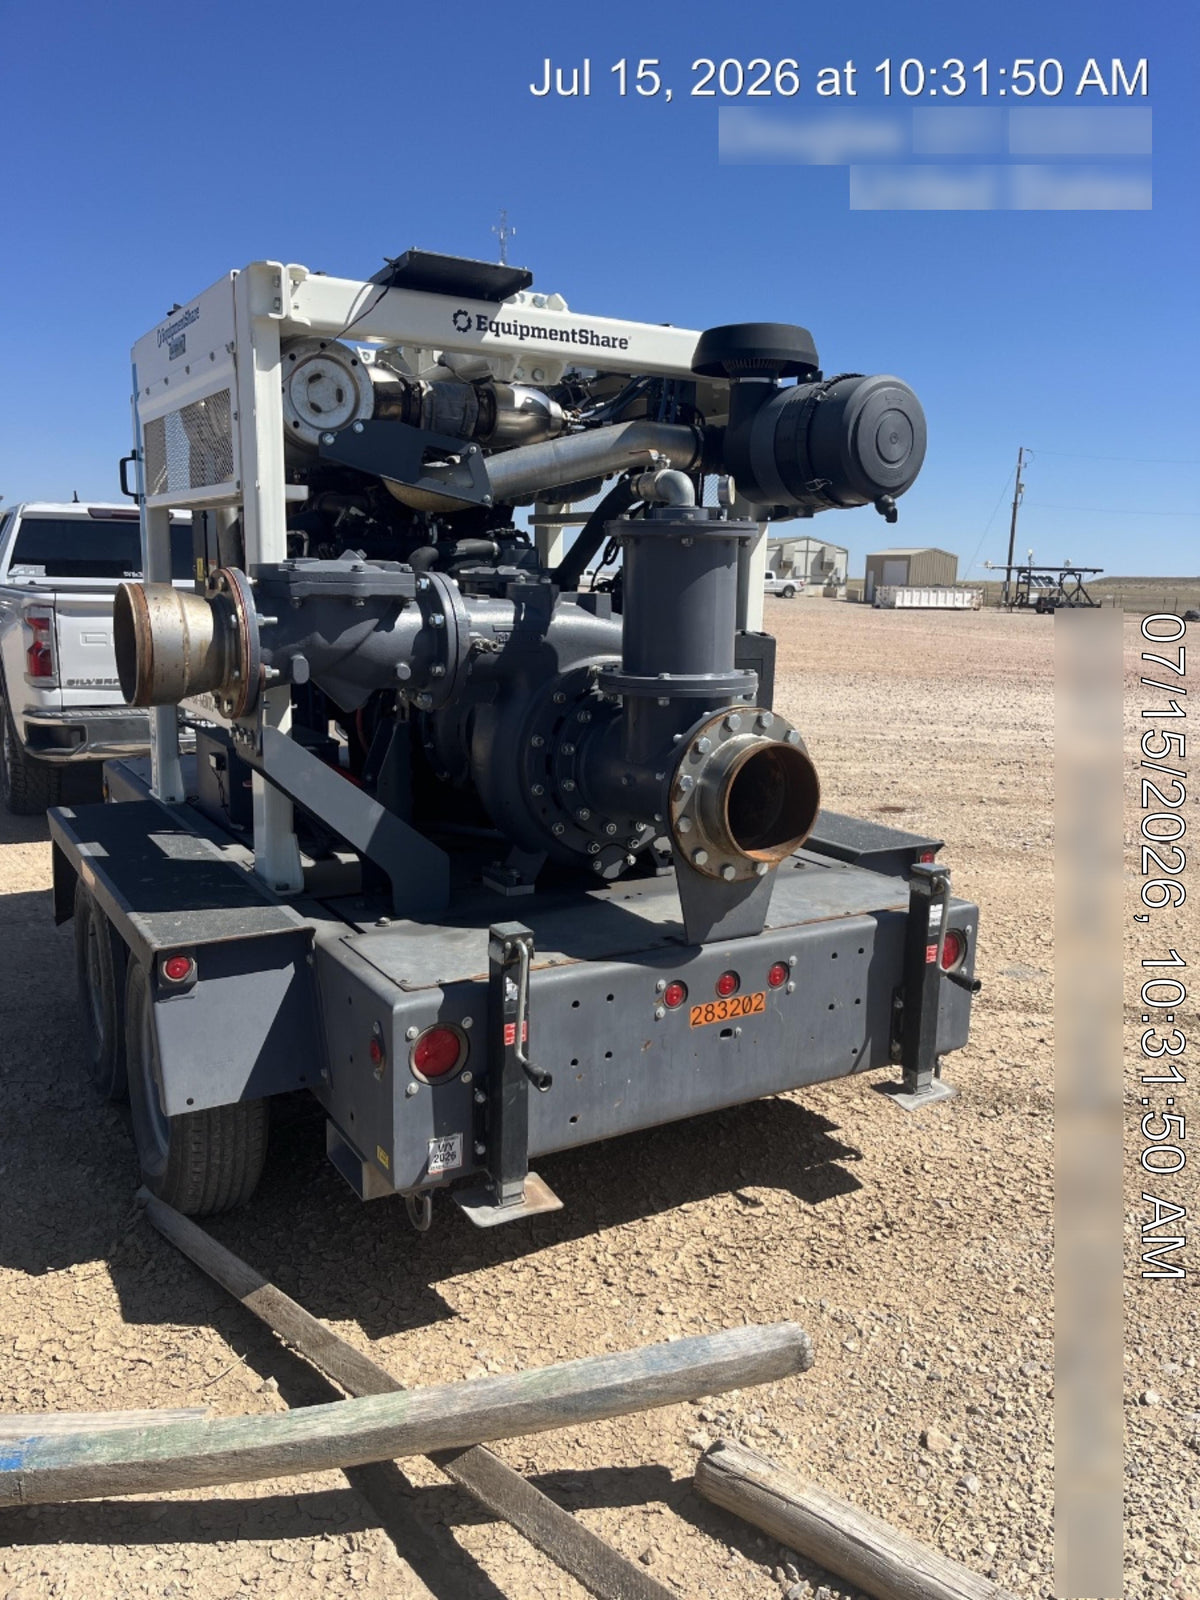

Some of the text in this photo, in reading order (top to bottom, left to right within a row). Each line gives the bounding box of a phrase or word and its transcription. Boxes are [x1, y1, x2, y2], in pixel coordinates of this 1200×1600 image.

[475, 313, 629, 350] EquipmentShare
[66, 677, 120, 686] SILVERA
[691, 992, 765, 1026] 283202
[433, 1150, 457, 1164] 2026
